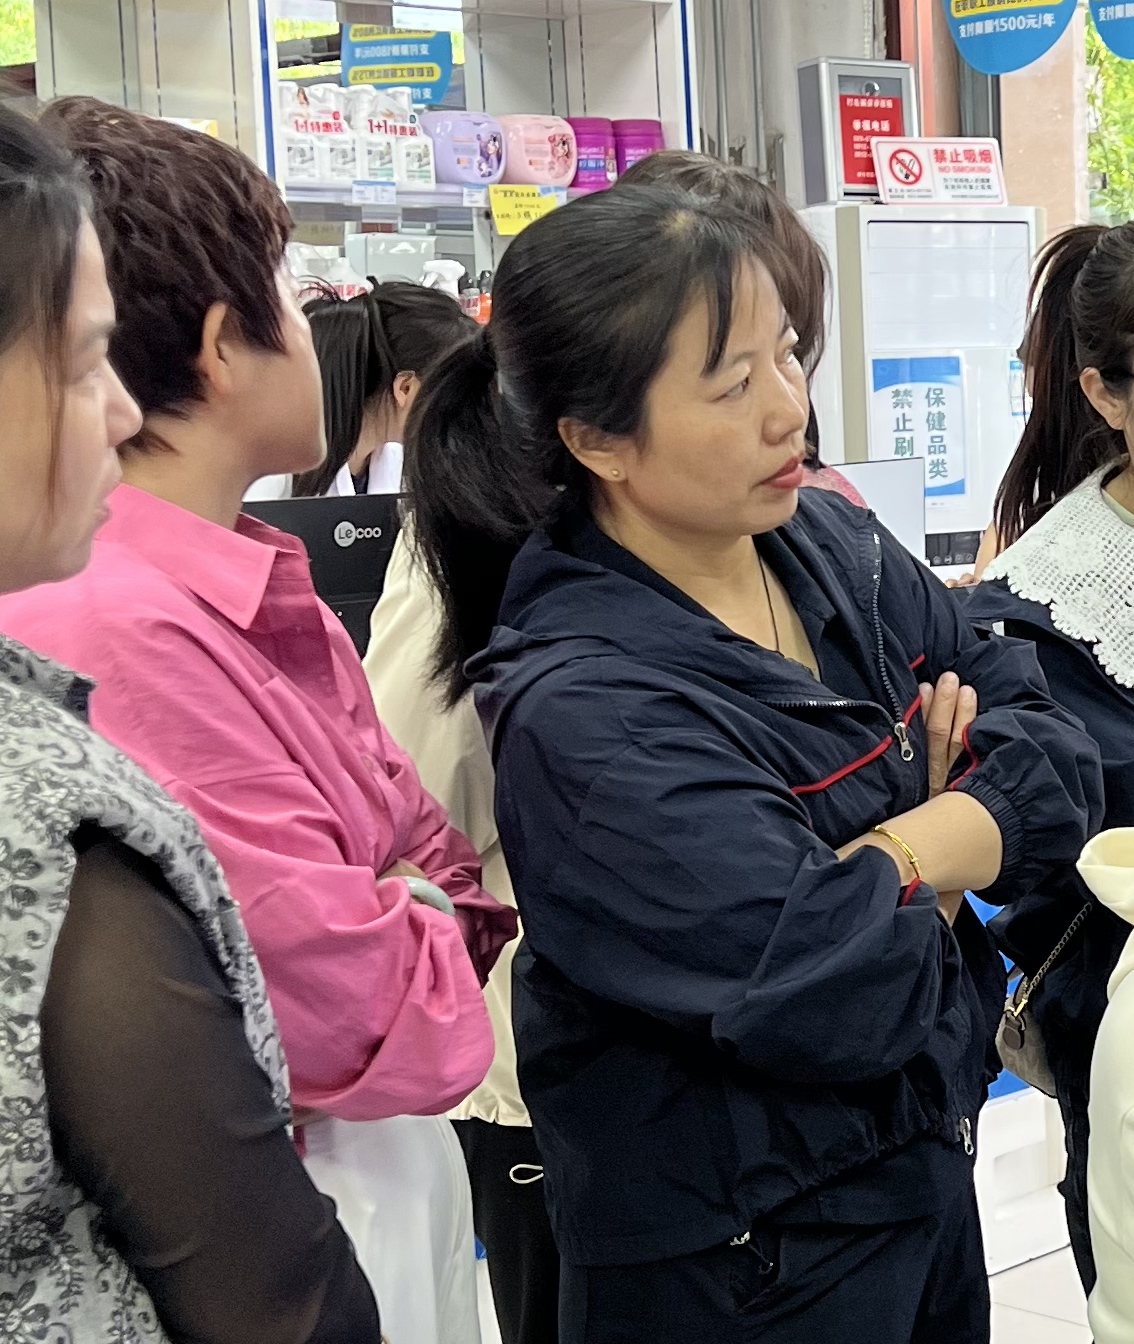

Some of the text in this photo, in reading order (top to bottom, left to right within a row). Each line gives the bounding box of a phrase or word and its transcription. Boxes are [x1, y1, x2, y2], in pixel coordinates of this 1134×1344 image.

[933, 148, 993, 164] 禁止吸烟
[938, 165, 991, 174] NO SMOKING
[924, 387, 948, 480] 保健品类
[336, 524, 382, 543] Lecoo
